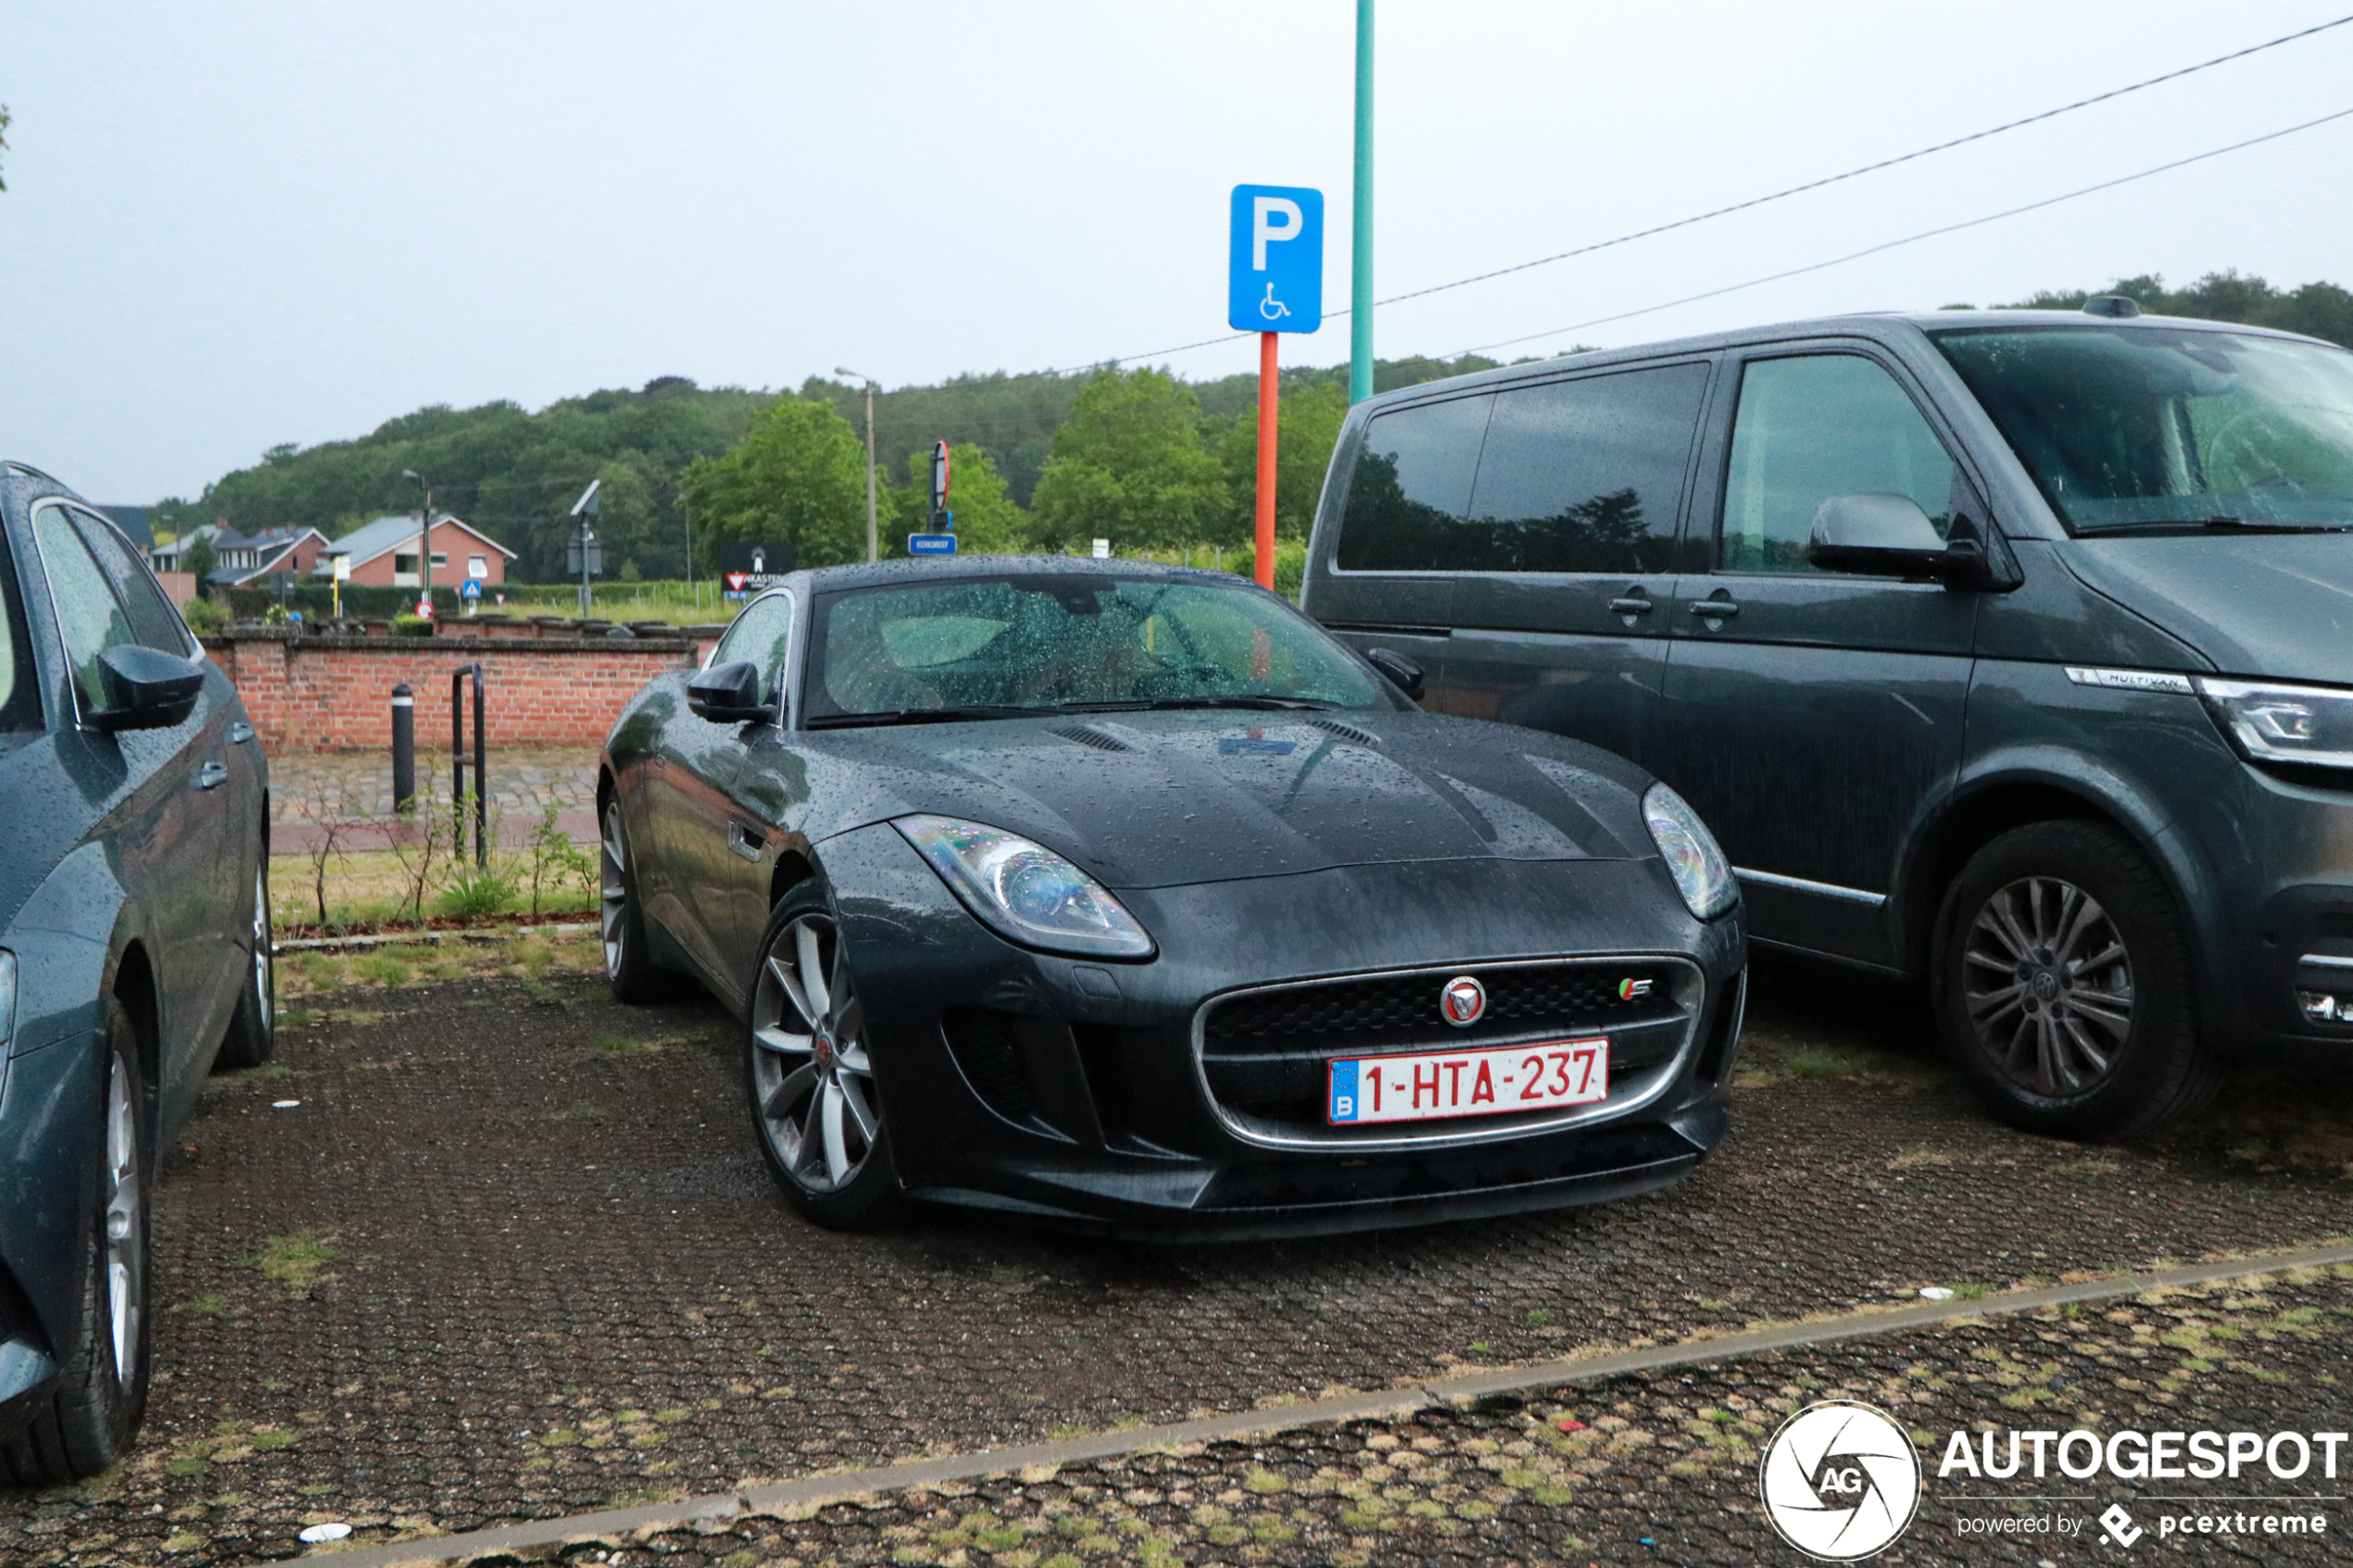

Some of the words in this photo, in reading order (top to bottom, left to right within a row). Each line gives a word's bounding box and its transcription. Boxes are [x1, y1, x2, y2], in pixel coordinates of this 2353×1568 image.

[1252, 196, 1303, 271] P
[2109, 675, 2179, 685] MULTIVAN
[1446, 977, 1483, 991] JAGUAR
[1365, 1048, 1597, 1112] 1-HTA-237
[1337, 1096, 1353, 1116] B
